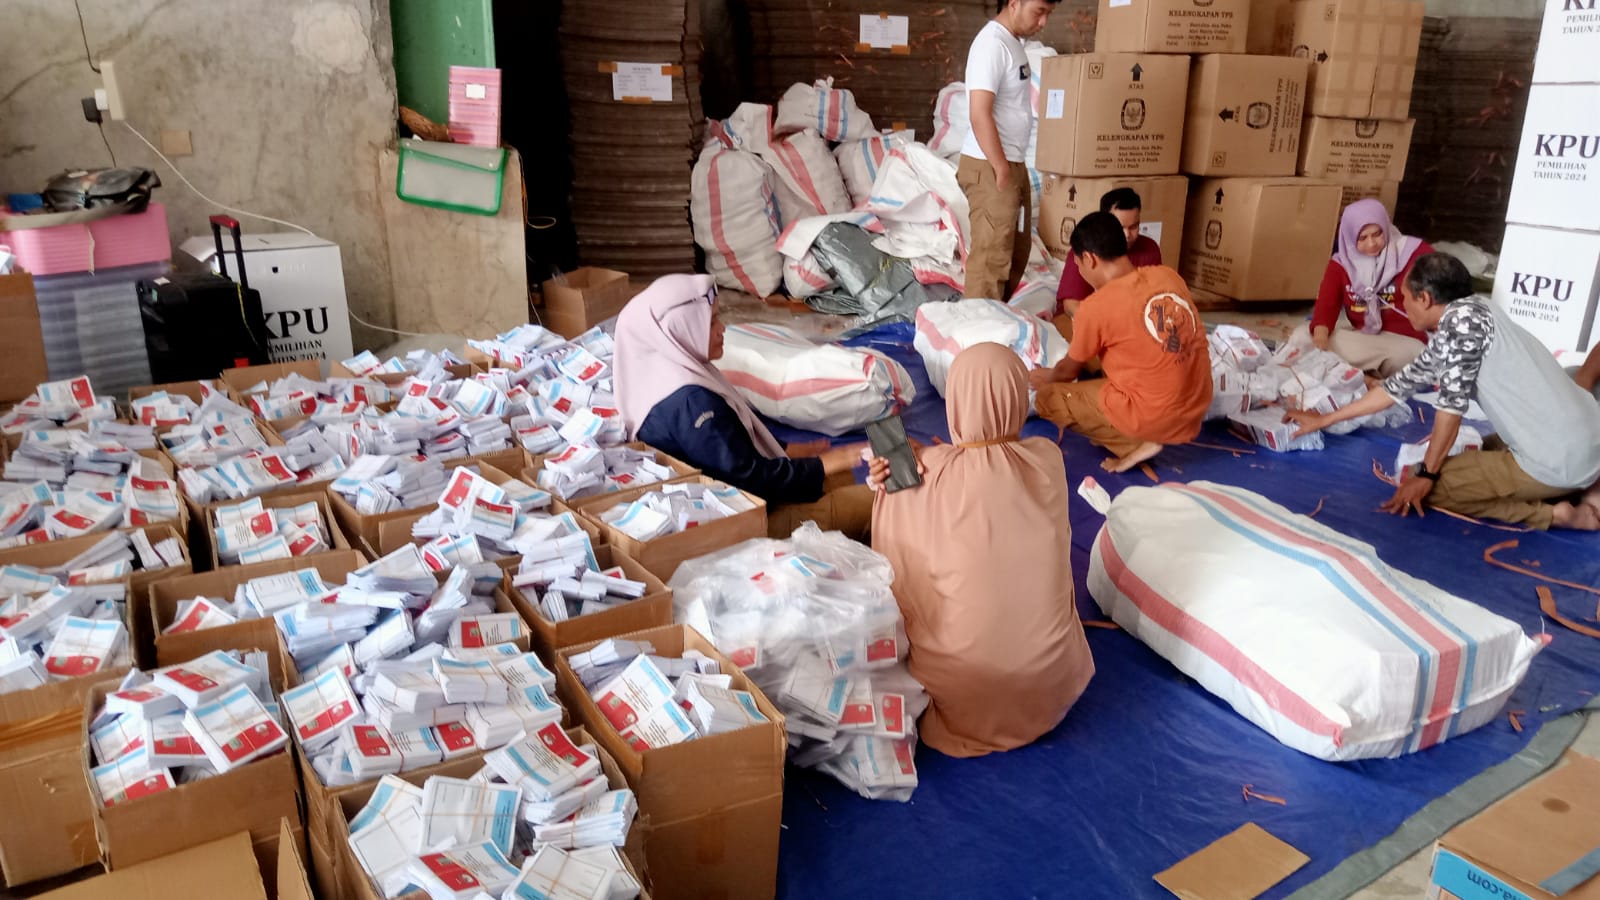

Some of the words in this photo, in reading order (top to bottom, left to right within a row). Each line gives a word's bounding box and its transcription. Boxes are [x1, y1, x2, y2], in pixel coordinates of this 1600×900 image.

[1096, 134, 1149, 142] KELENGKAPAN
[1534, 134, 1600, 159] KPU
[1537, 161, 1587, 170] PEMILIHAN
[1533, 171, 1562, 179] TAHUN
[1565, 172, 1587, 182] 2024
[1510, 271, 1574, 302] KPU
[1513, 297, 1560, 312] PEMILIHAN
[1509, 306, 1536, 318] TAHUN
[1538, 312, 1560, 322] 2024
